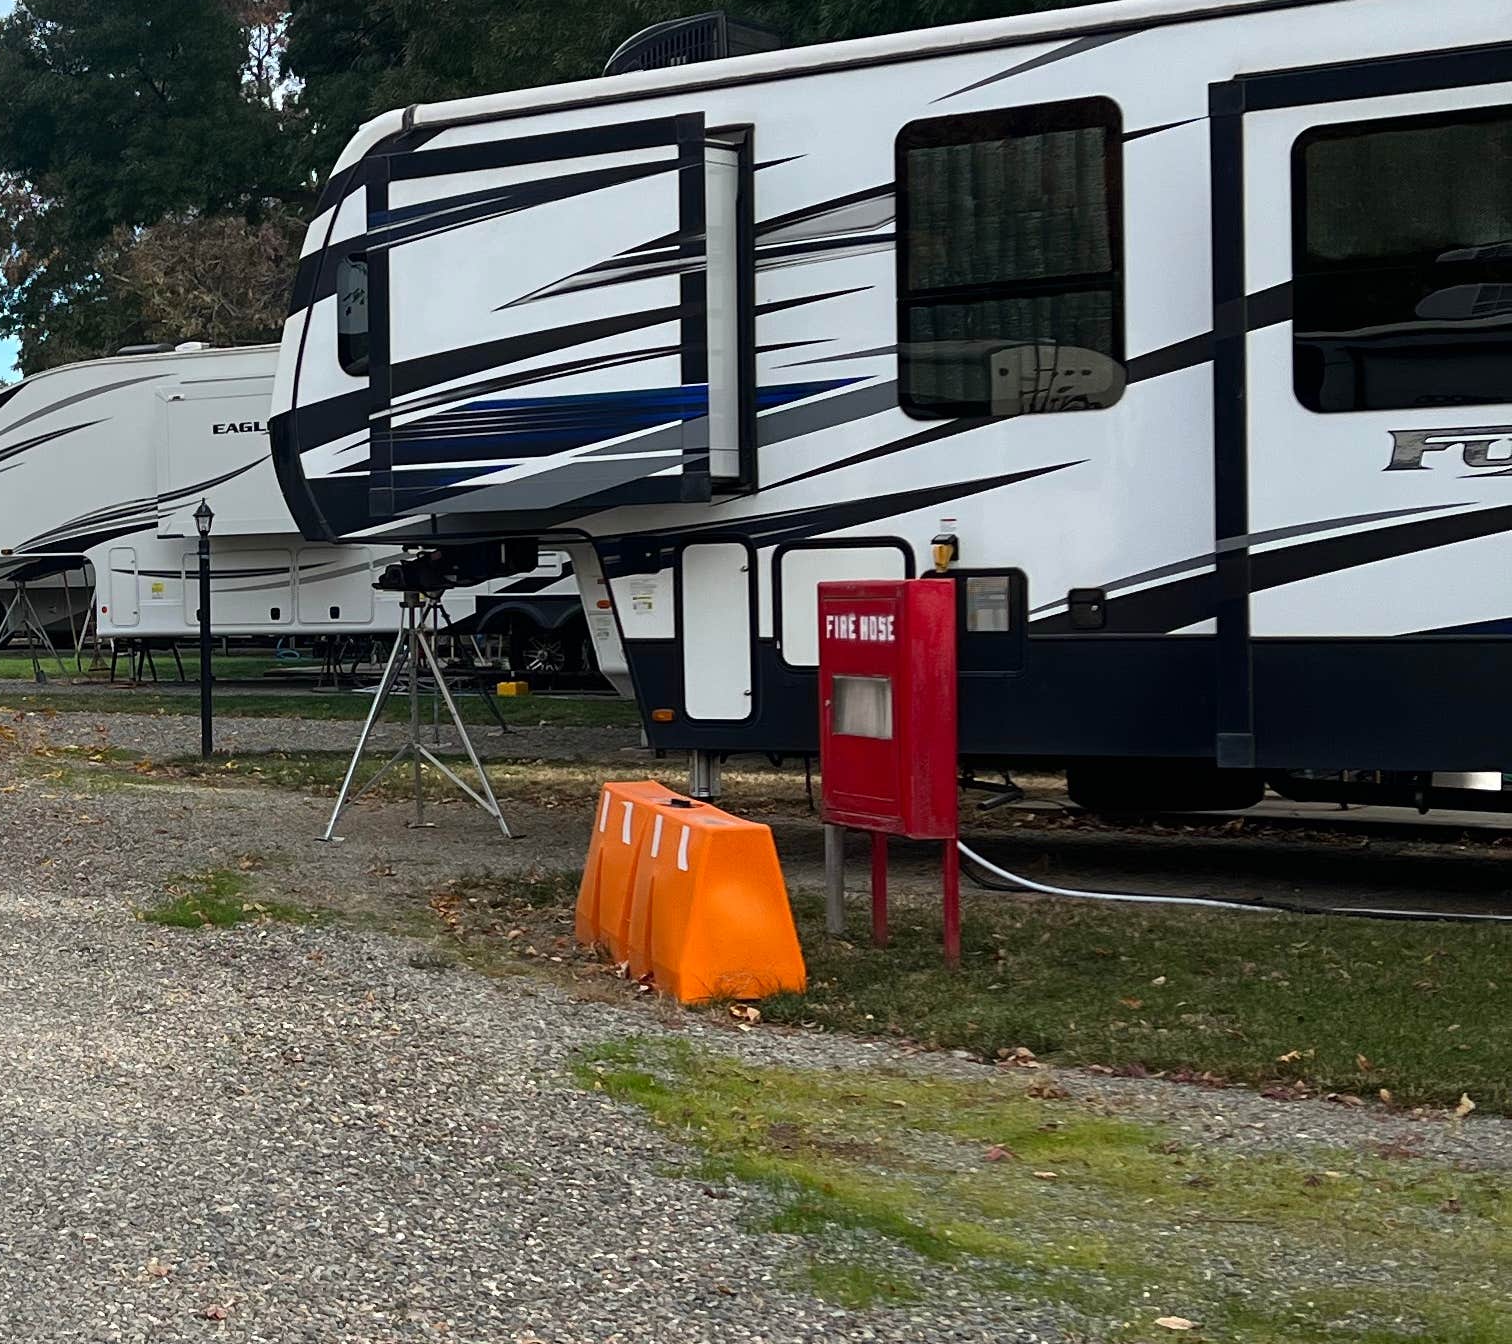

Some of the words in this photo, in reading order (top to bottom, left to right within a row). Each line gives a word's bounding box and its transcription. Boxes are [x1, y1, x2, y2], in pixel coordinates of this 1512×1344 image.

[213, 421, 269, 434] EAGL
[826, 613, 857, 639] FIRE
[860, 615, 896, 641] HOSE
